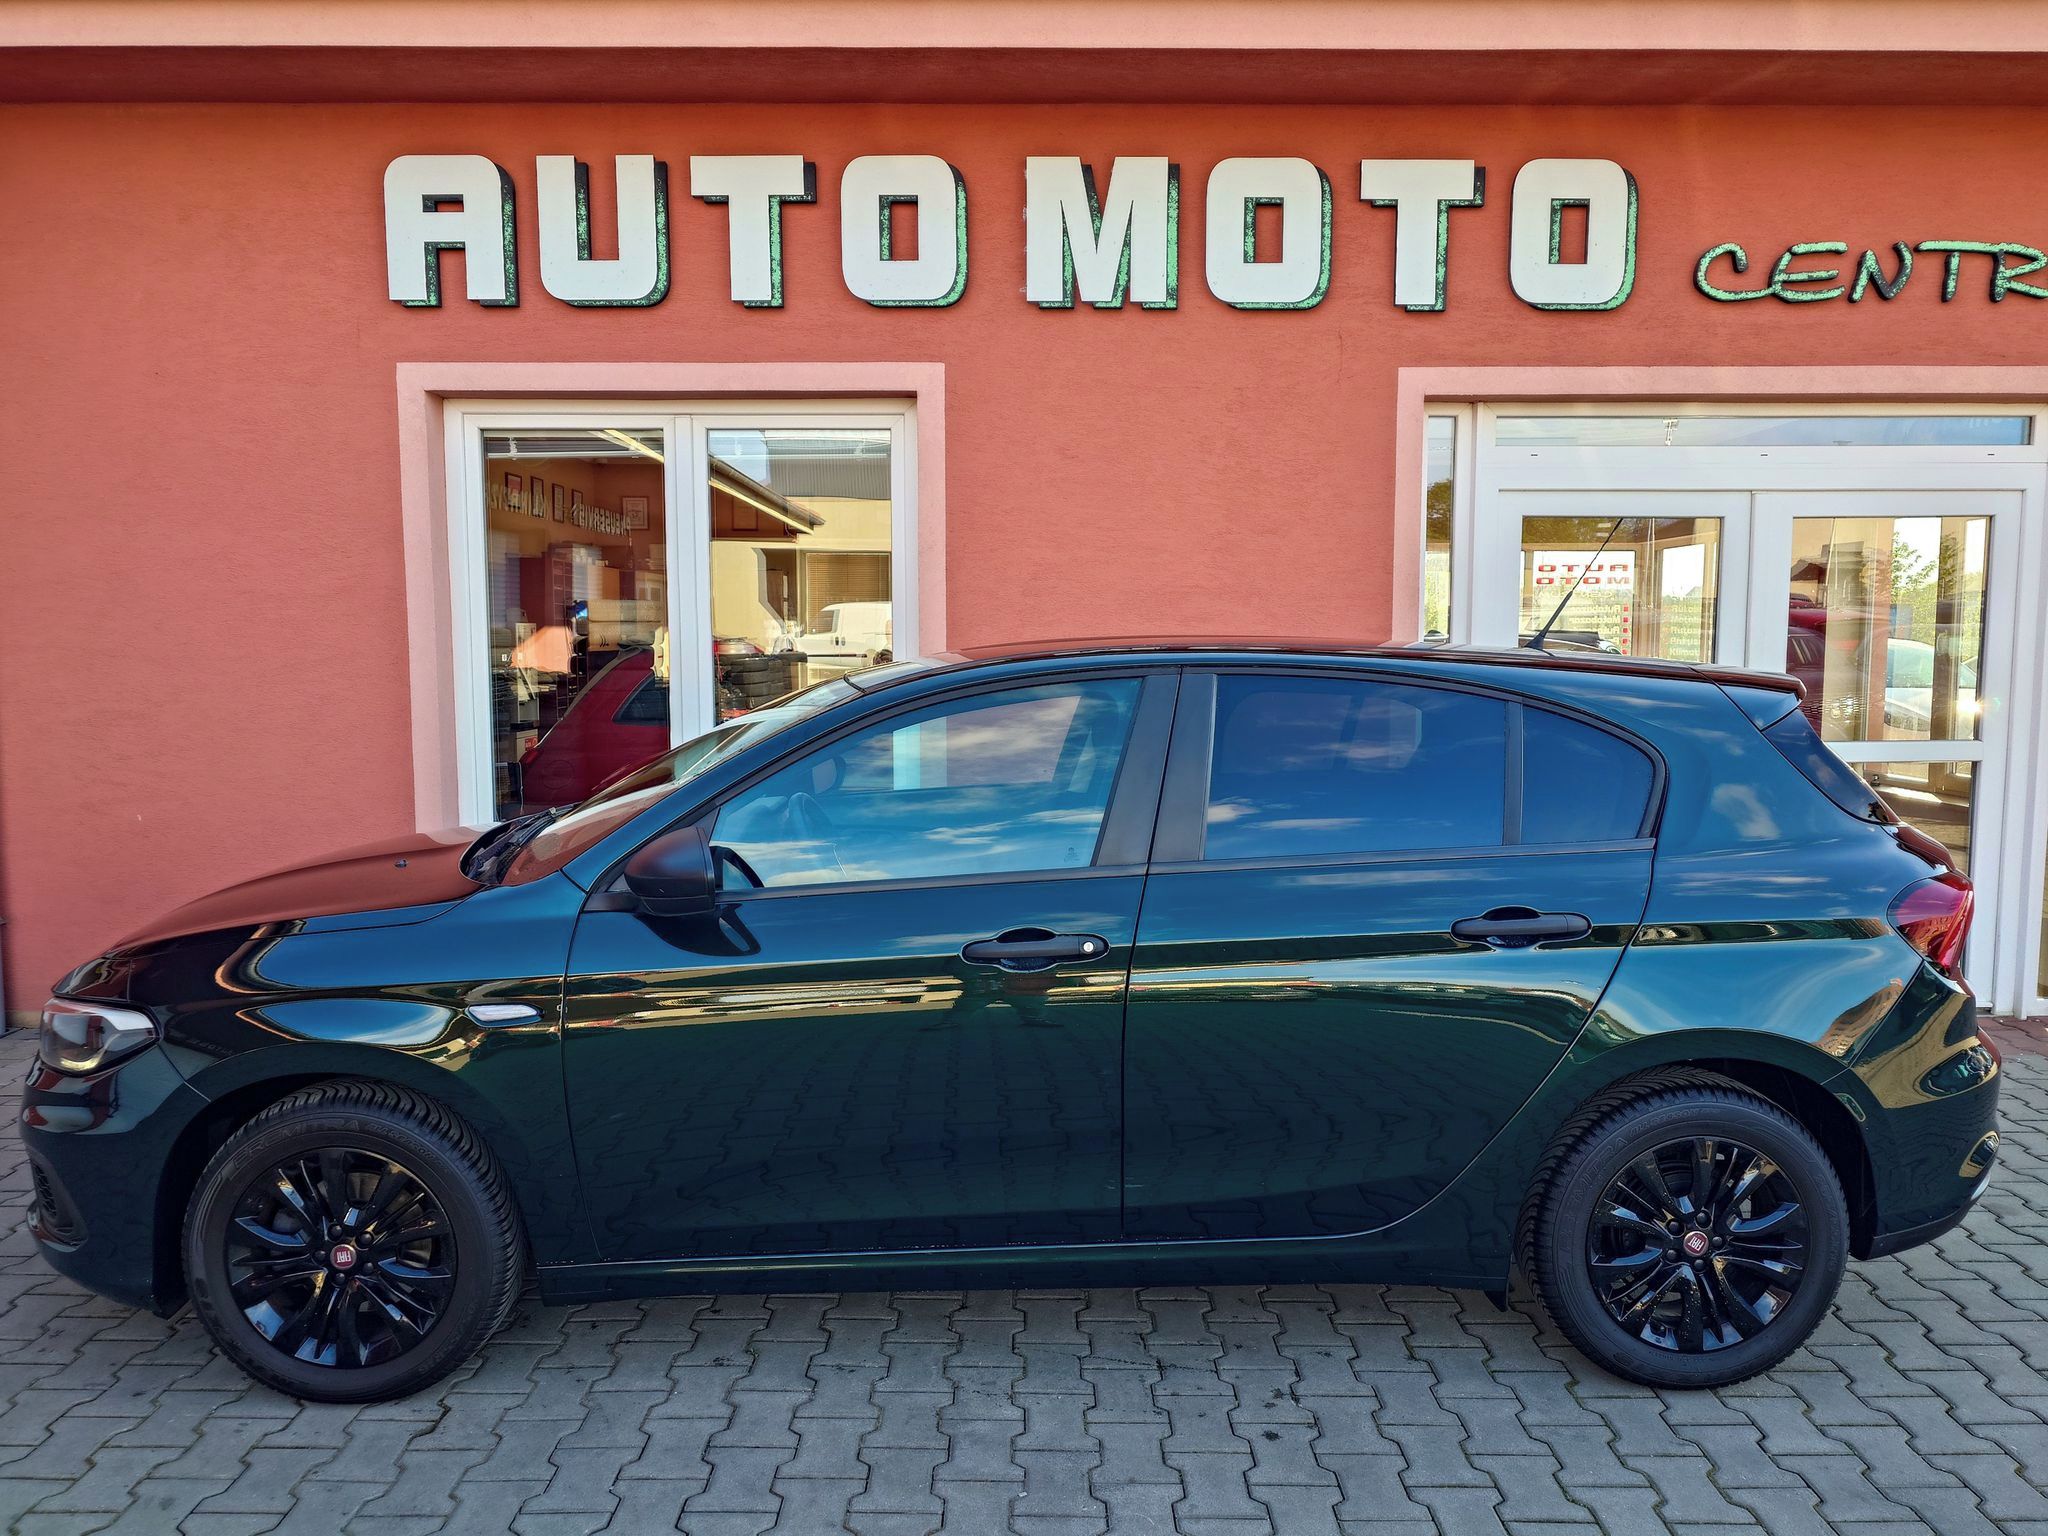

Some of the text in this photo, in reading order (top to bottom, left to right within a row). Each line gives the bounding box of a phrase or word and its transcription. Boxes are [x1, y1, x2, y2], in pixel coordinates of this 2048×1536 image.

[384, 154, 968, 308] AUTO
[1026, 155, 1639, 312] MOTO
[1686, 1235, 1705, 1252] FIAT
[336, 1250, 352, 1263] FIAT
